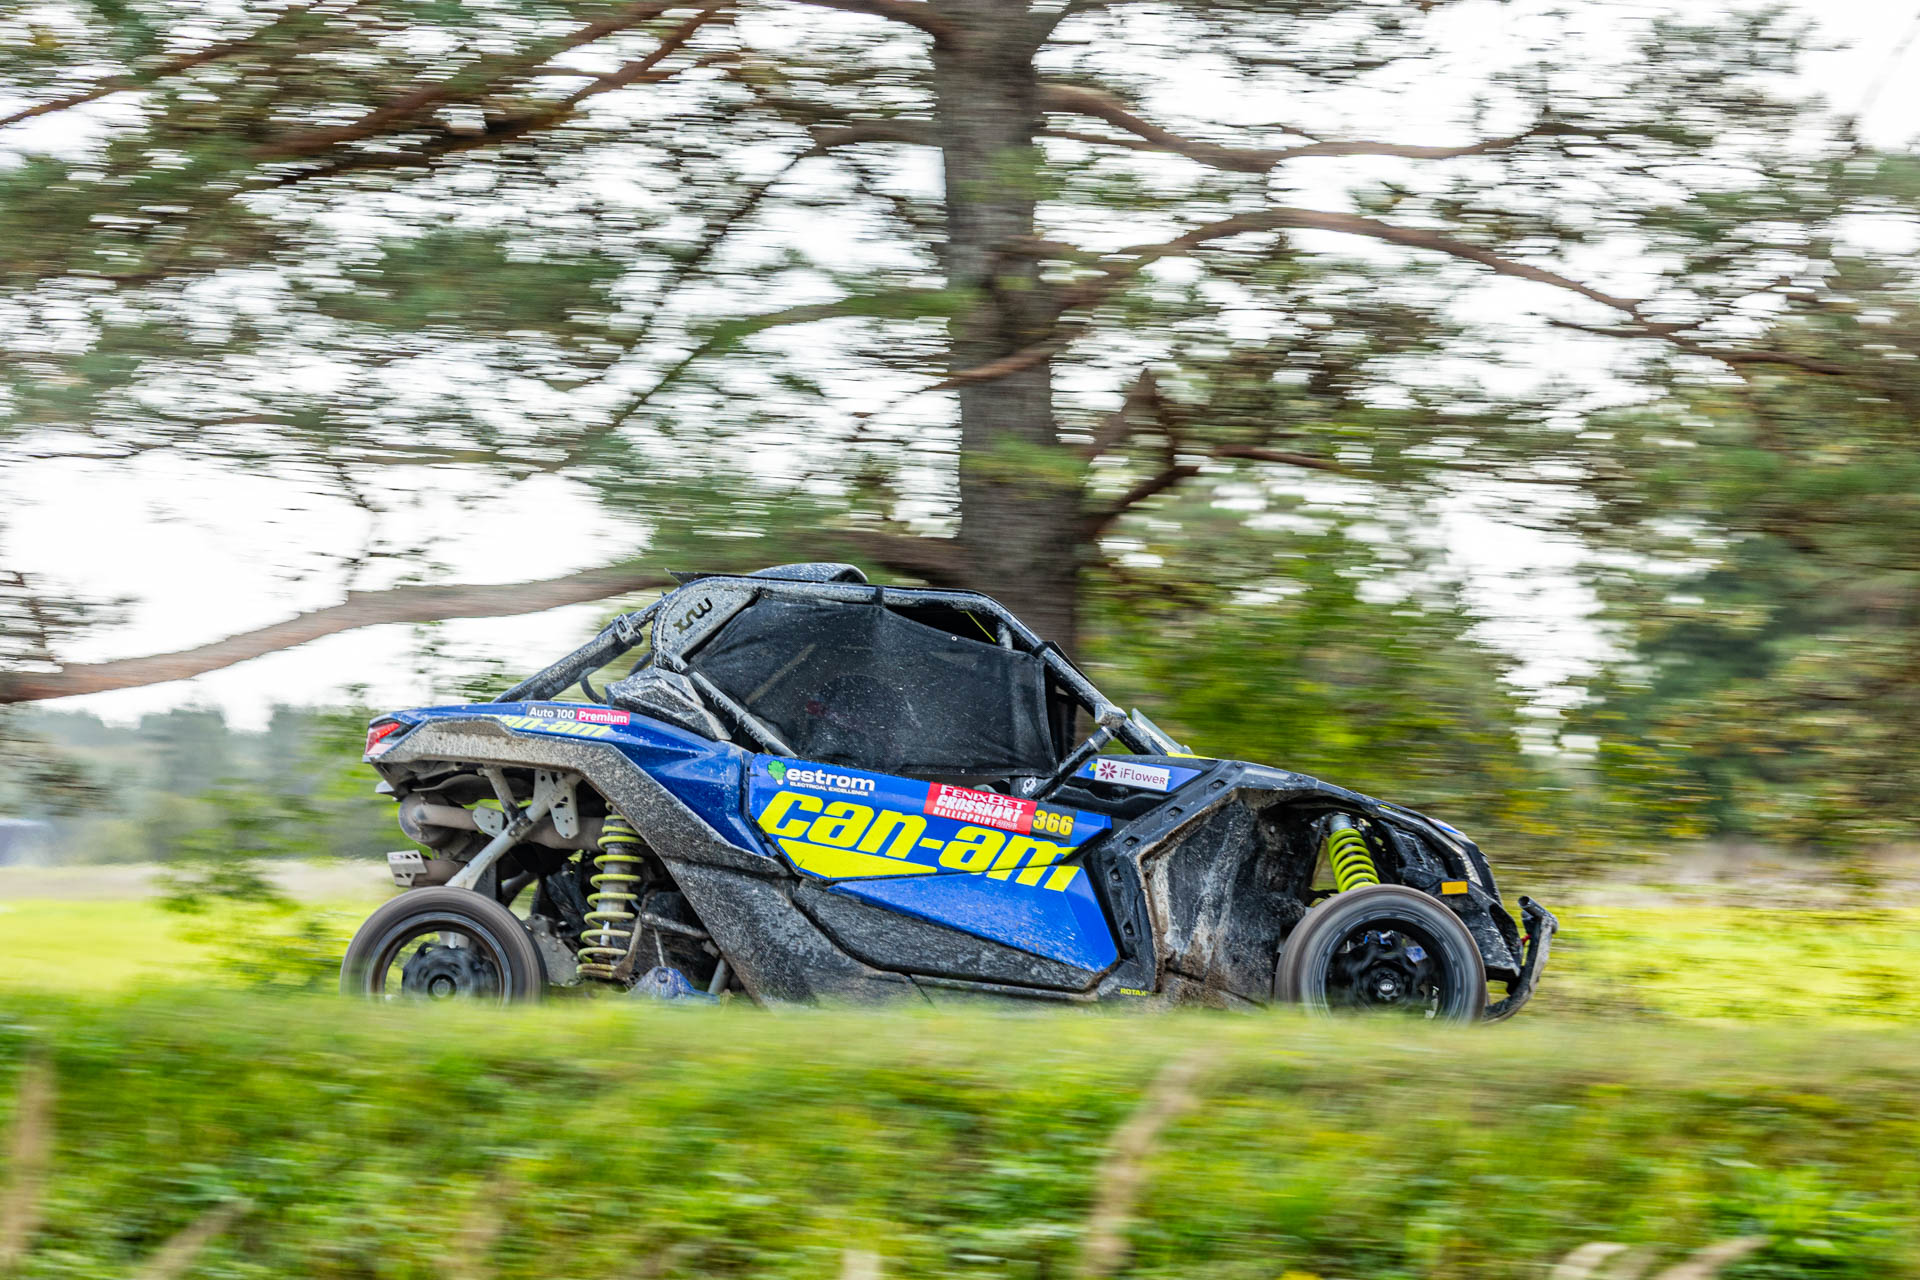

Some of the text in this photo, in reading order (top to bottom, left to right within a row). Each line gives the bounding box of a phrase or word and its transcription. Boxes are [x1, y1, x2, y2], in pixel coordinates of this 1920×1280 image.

[494, 715, 611, 737] an-am
[529, 707, 628, 724] Auto 100 Premium
[786, 768, 875, 791] estrom
[789, 781, 869, 797] ELECTRICAL EXCELLENCE
[932, 806, 997, 826] RALLISPRINT
[936, 794, 1023, 823] CROSSKART
[1032, 810, 1074, 836] 366
[757, 790, 1081, 892] can-am
[1120, 988, 1147, 996] ROTAX
